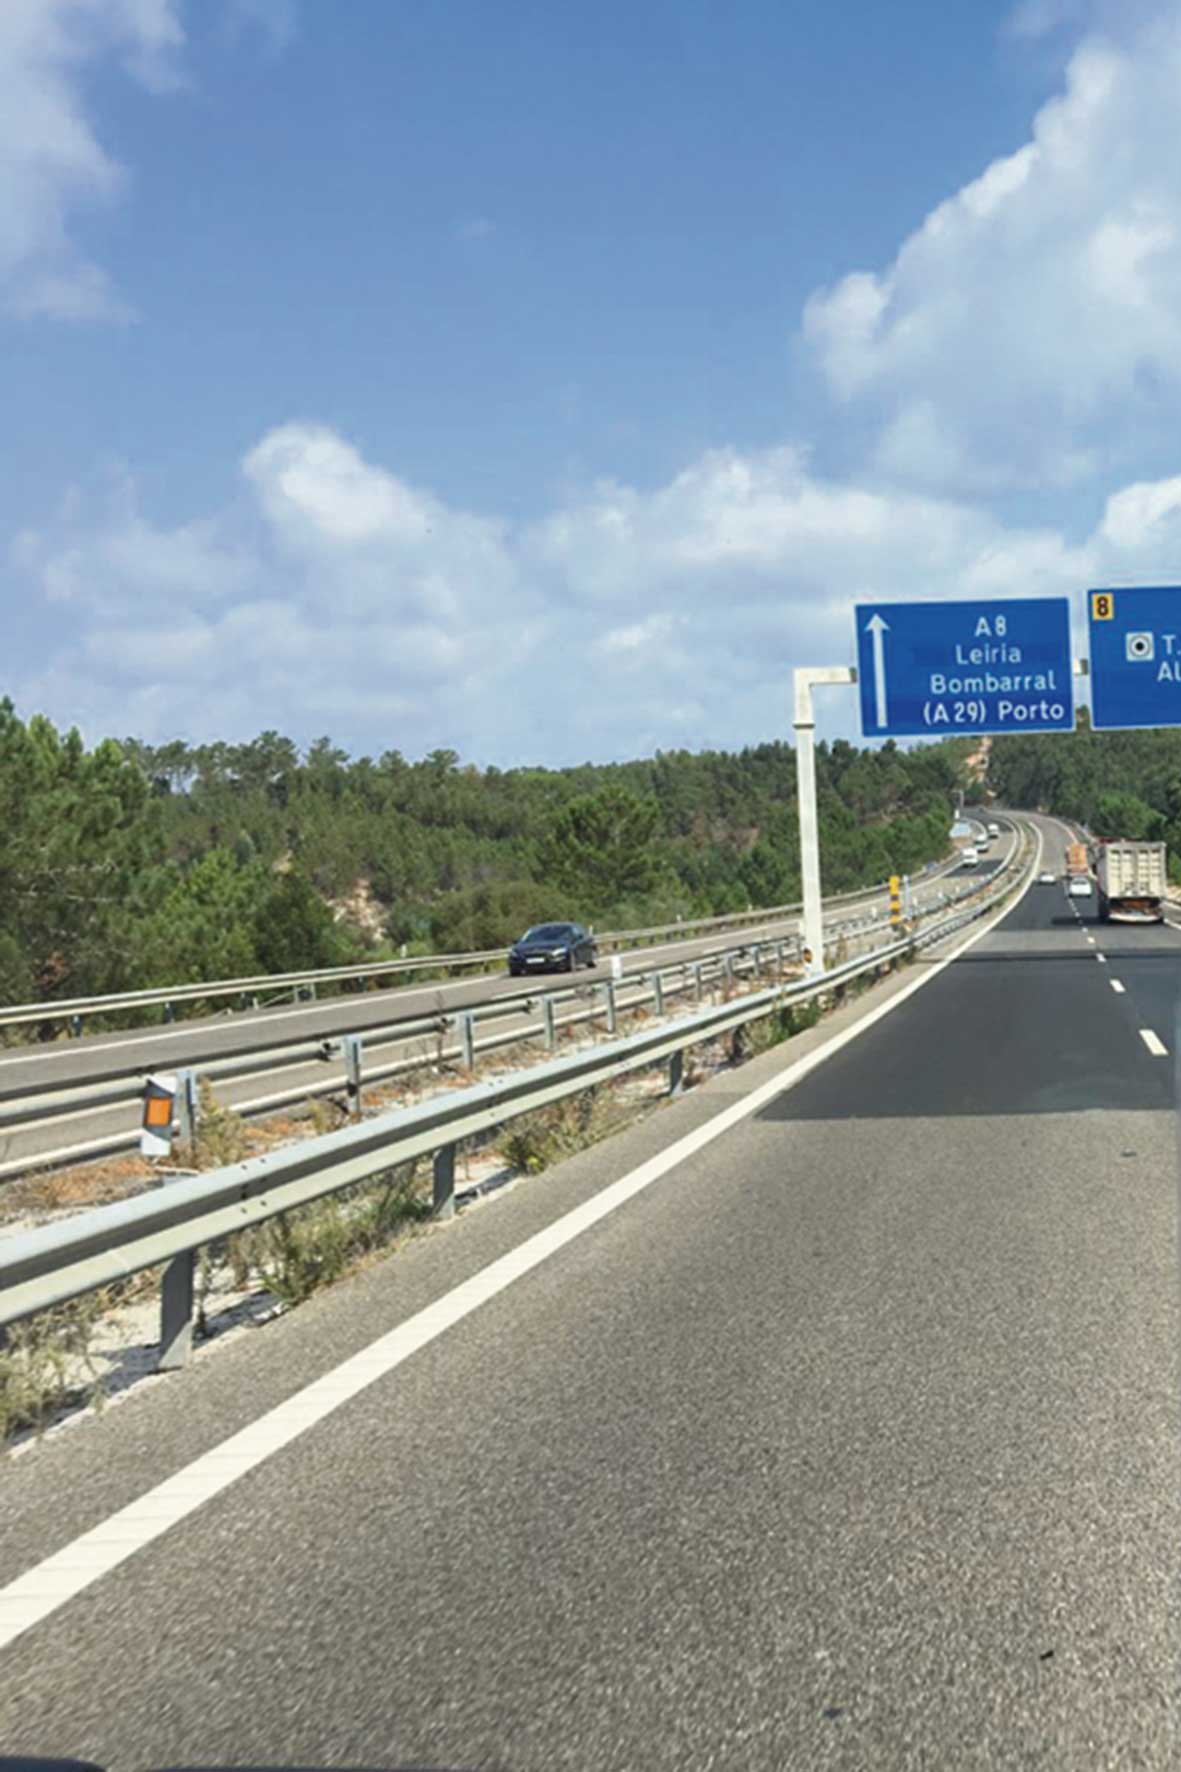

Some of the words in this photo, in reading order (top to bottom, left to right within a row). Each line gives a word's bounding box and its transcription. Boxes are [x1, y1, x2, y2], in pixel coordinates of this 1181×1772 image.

[1098, 595, 1110, 618] 8
[955, 643, 1022, 665] Leiria
[930, 669, 1057, 694] Bombarral
[998, 699, 1065, 721] Porto
